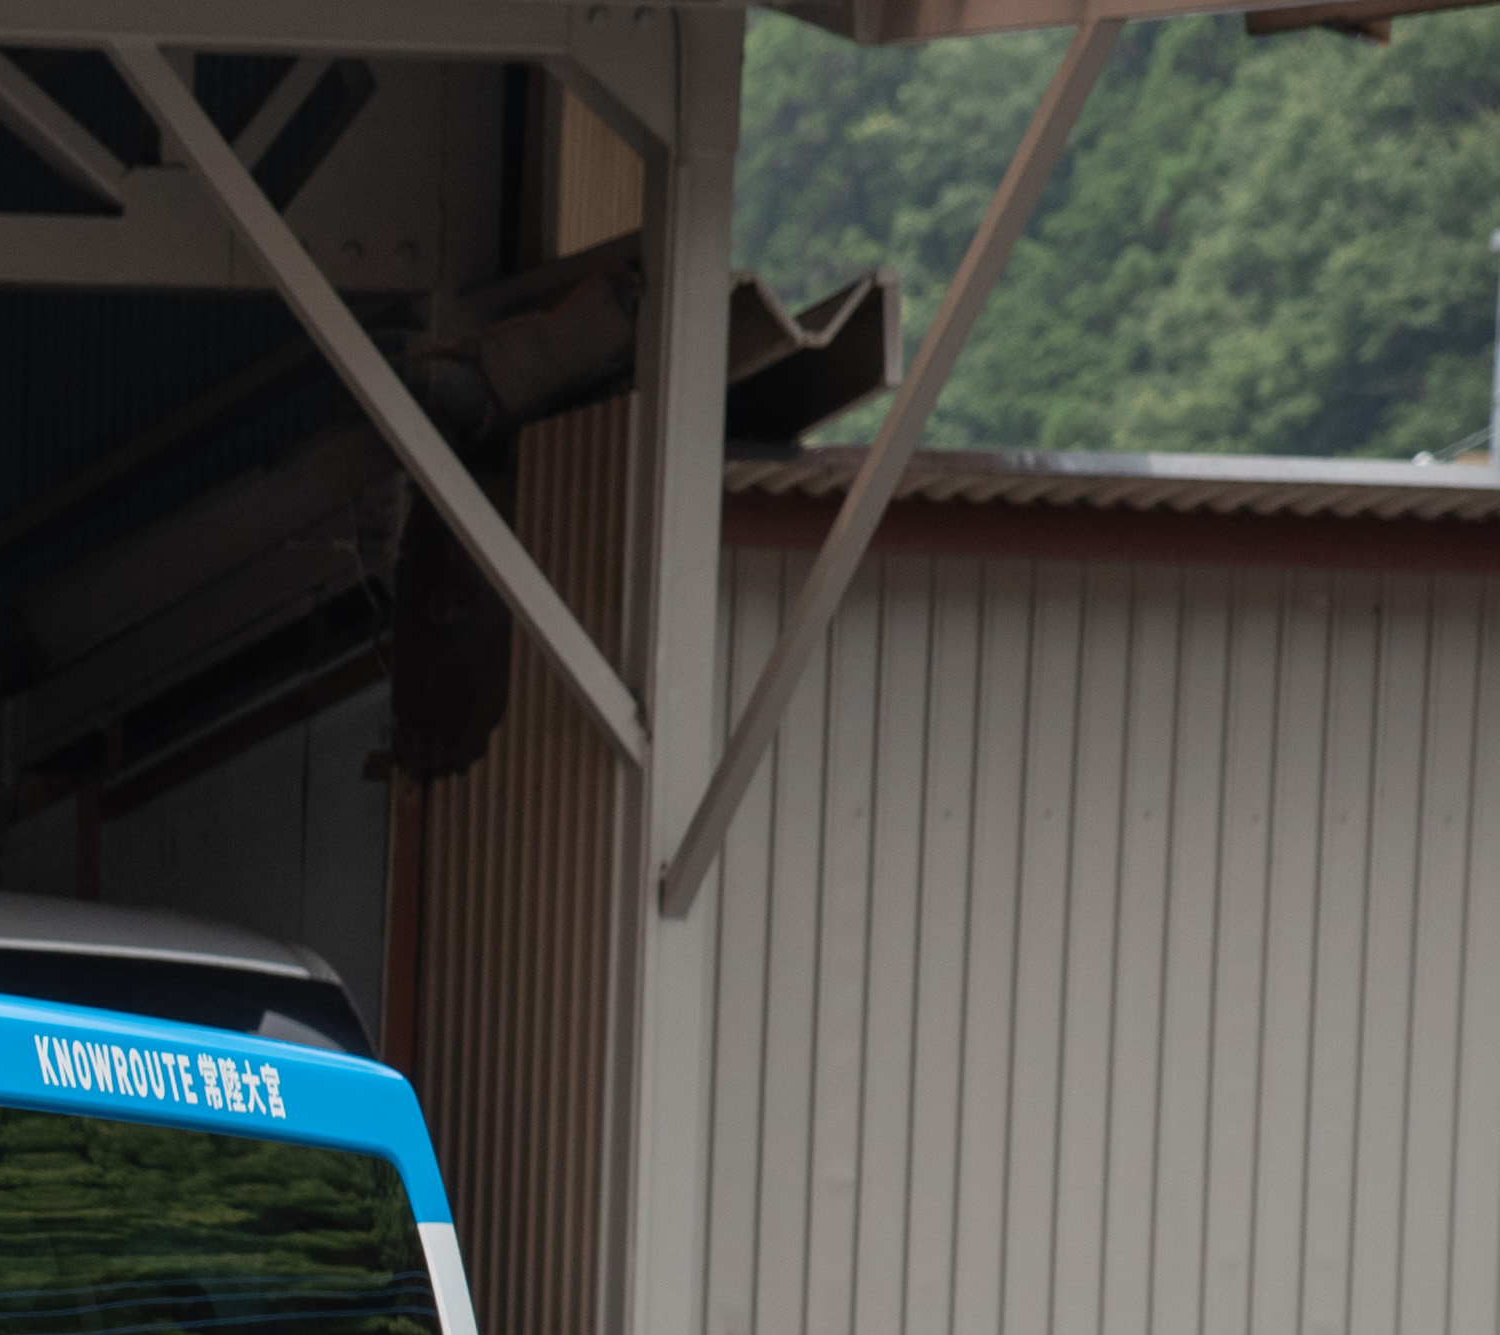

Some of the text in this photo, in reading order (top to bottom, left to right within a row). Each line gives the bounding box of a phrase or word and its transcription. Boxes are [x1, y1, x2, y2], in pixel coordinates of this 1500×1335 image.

[33, 1033, 288, 1121] KNOWROUTE 常陸大宮
